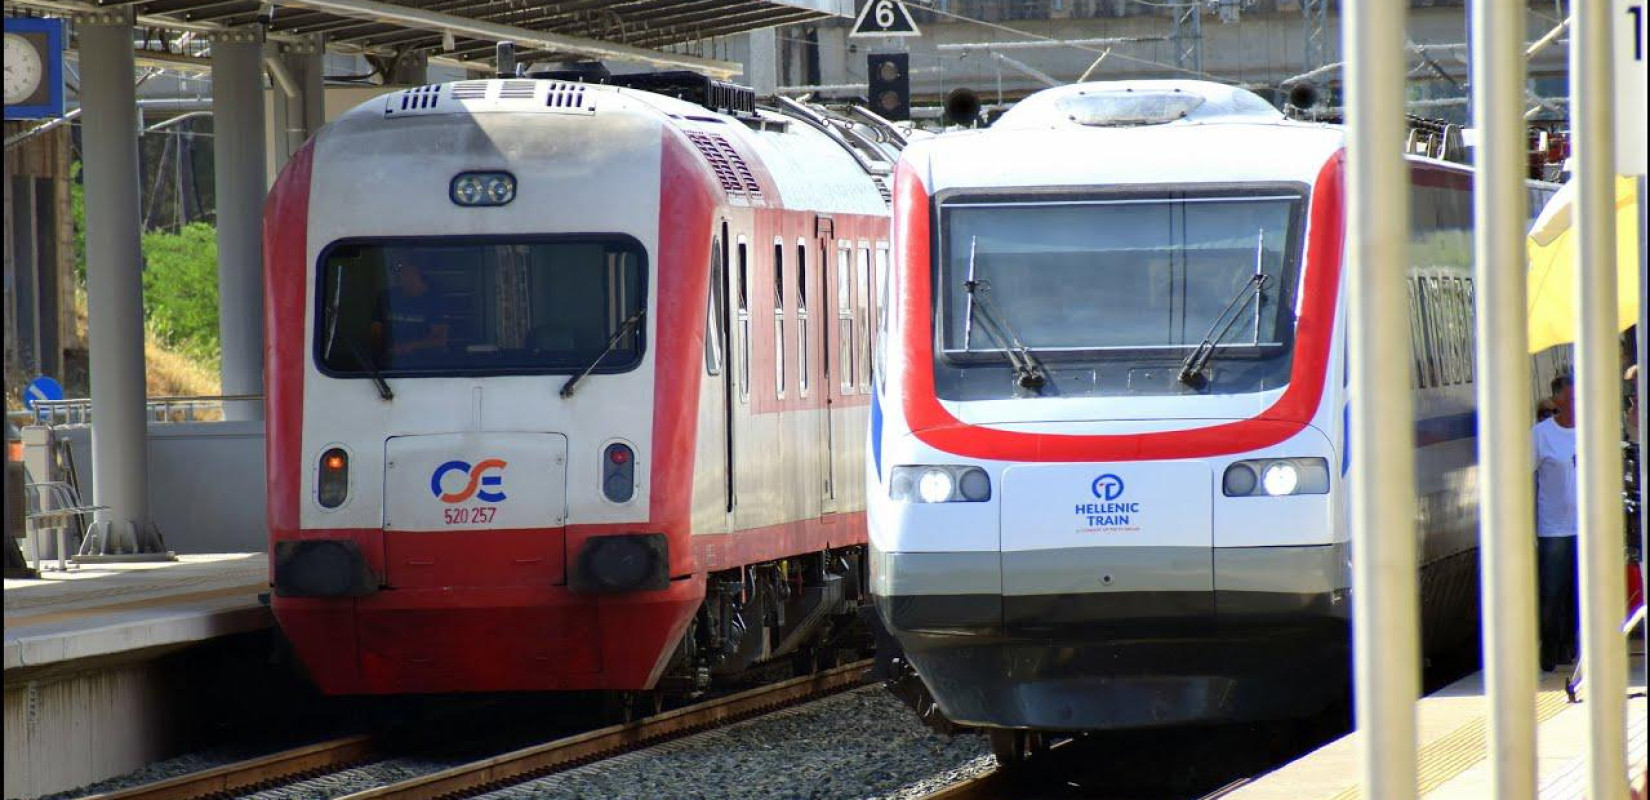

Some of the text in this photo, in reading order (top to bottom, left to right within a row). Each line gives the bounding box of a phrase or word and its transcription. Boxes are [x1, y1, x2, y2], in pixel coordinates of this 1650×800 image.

[875, 0, 895, 28] 6
[1626, 5, 1642, 61] 1
[444, 507, 496, 525] 520 257
[1075, 502, 1140, 514] HELLENIC
[1086, 515, 1129, 526] TRAIN
